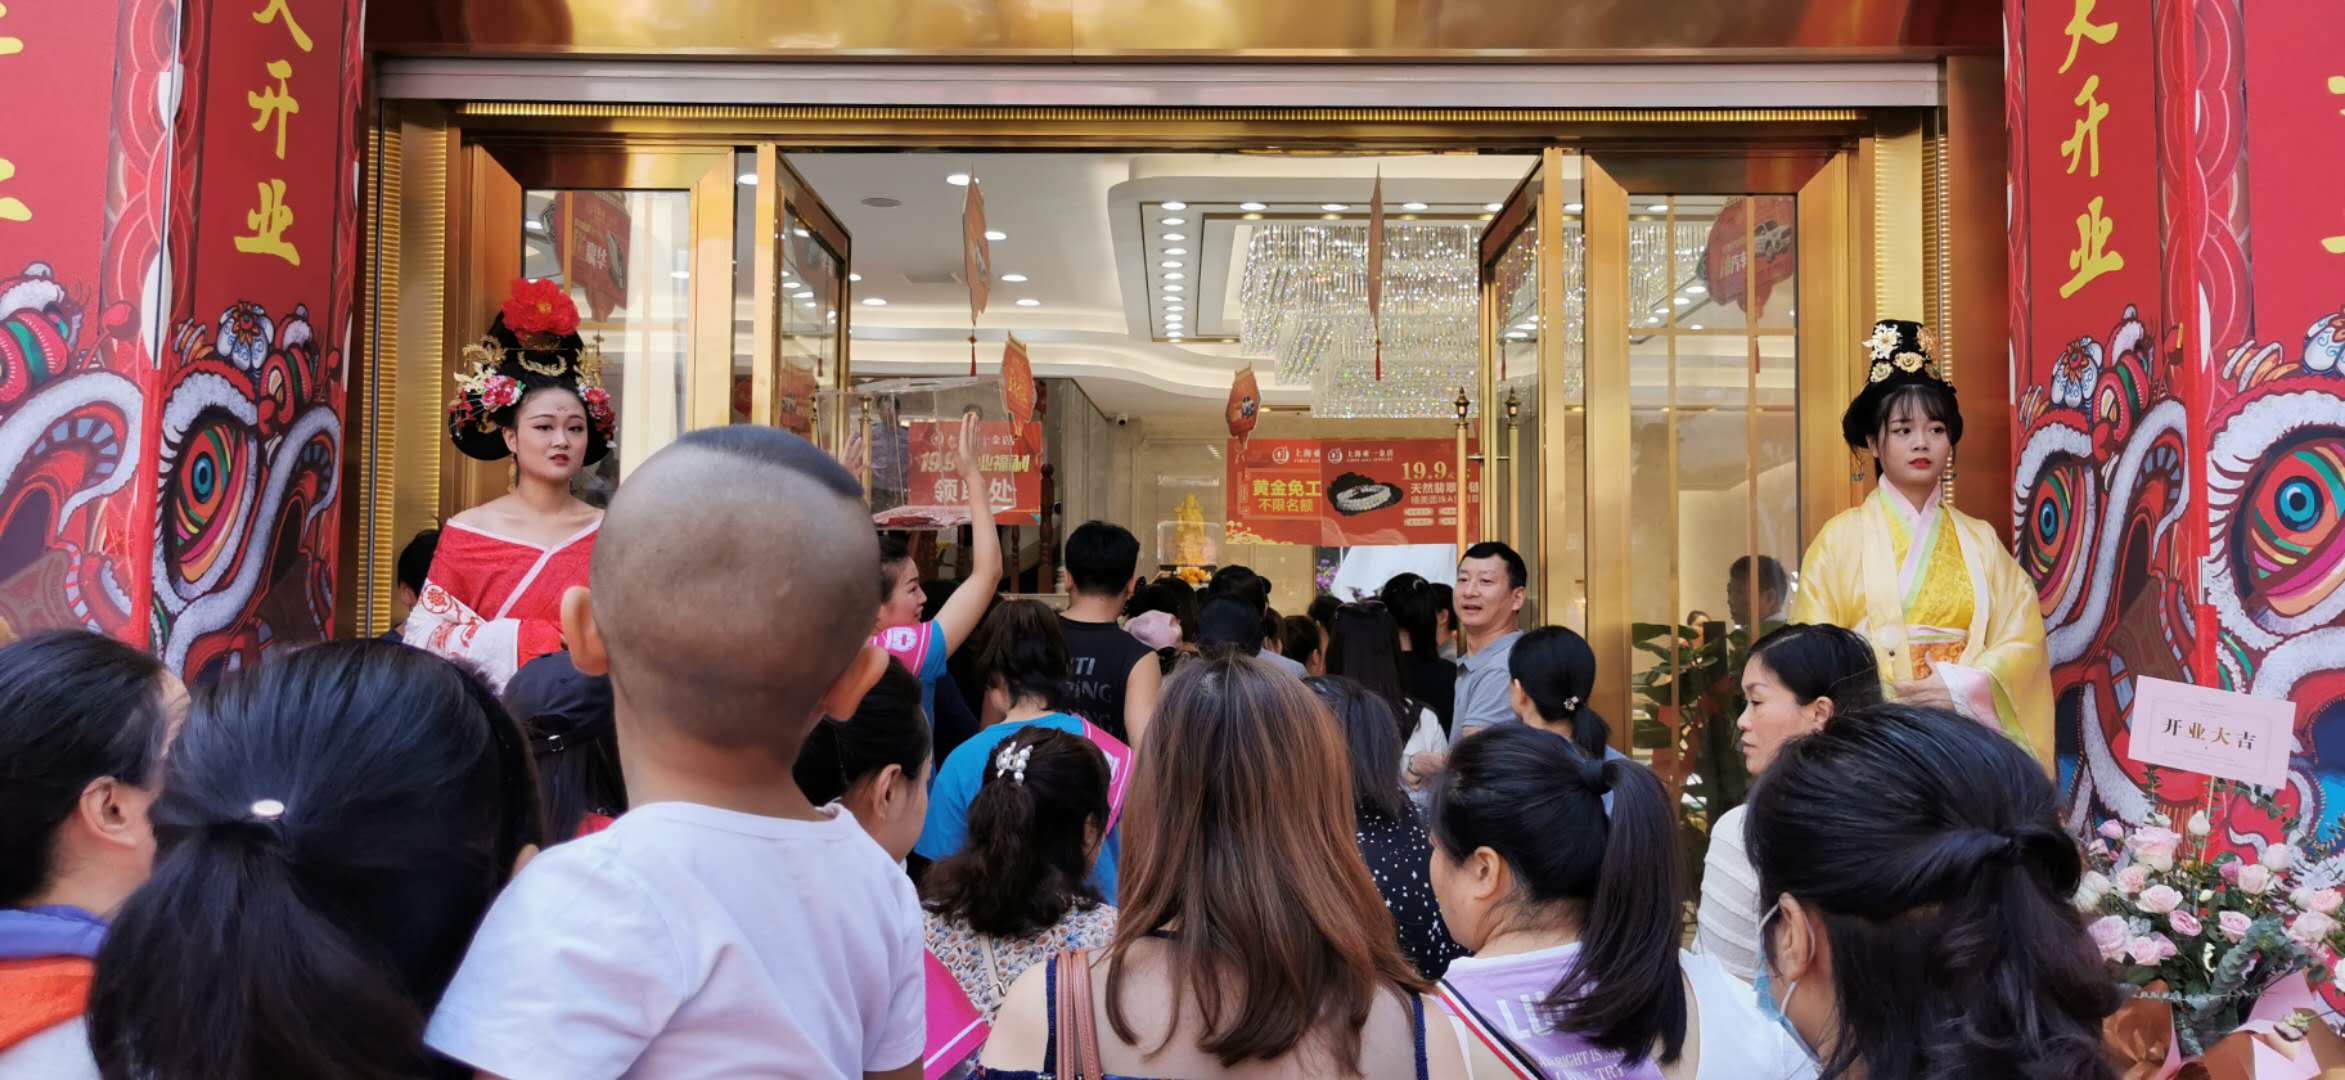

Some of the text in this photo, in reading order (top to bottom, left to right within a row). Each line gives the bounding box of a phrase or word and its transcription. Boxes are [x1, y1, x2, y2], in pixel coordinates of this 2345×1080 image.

[1253, 479, 1322, 497] 黄金免工
[1258, 498, 1314, 513] 不限名额
[2164, 718, 2256, 750] 开业大吉
